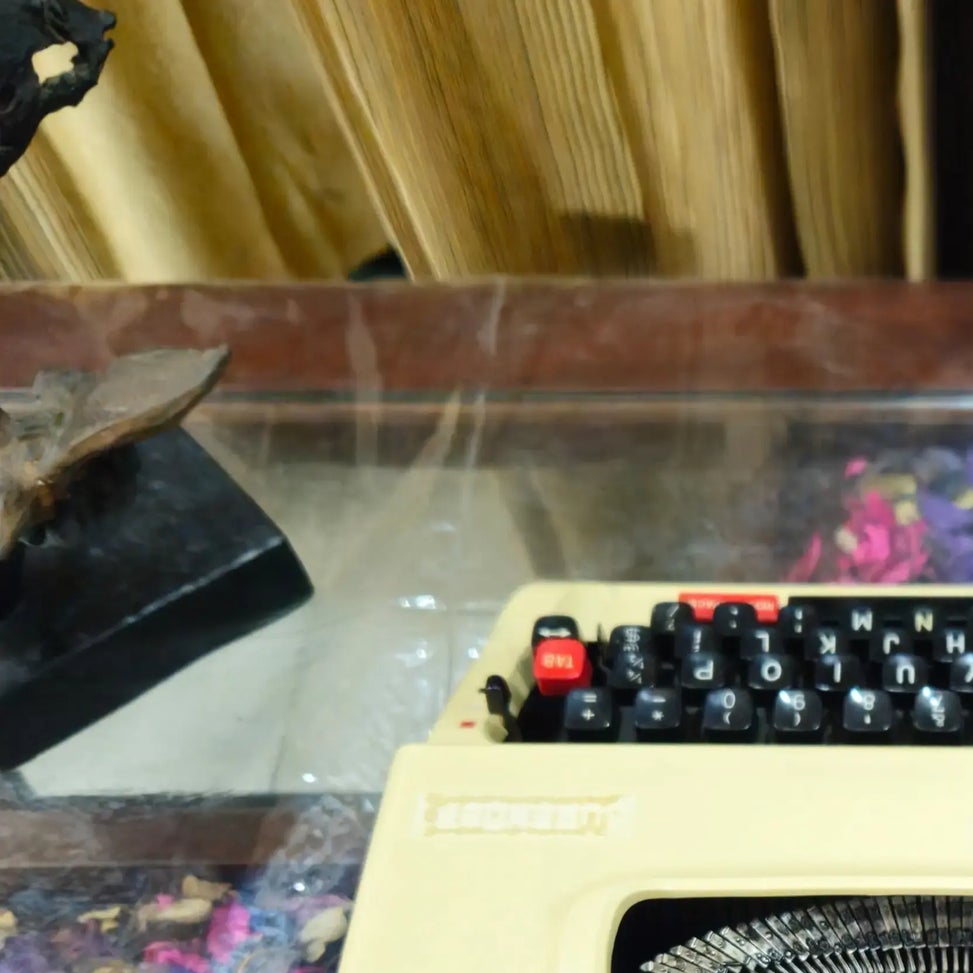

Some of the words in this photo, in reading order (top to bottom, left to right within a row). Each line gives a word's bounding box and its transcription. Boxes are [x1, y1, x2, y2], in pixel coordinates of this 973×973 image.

[852, 610, 872, 631] M
[915, 611, 933, 632] N
[754, 630, 769, 652] L
[820, 632, 836, 654] K
[883, 632, 900, 654] J
[946, 632, 965, 654] H
[543, 654, 574, 669] TAB
[694, 660, 714, 680] P
[761, 660, 782, 681] O
[896, 665, 915, 684] U
[793, 691, 805, 711] 9
[863, 694, 876, 710] 8
